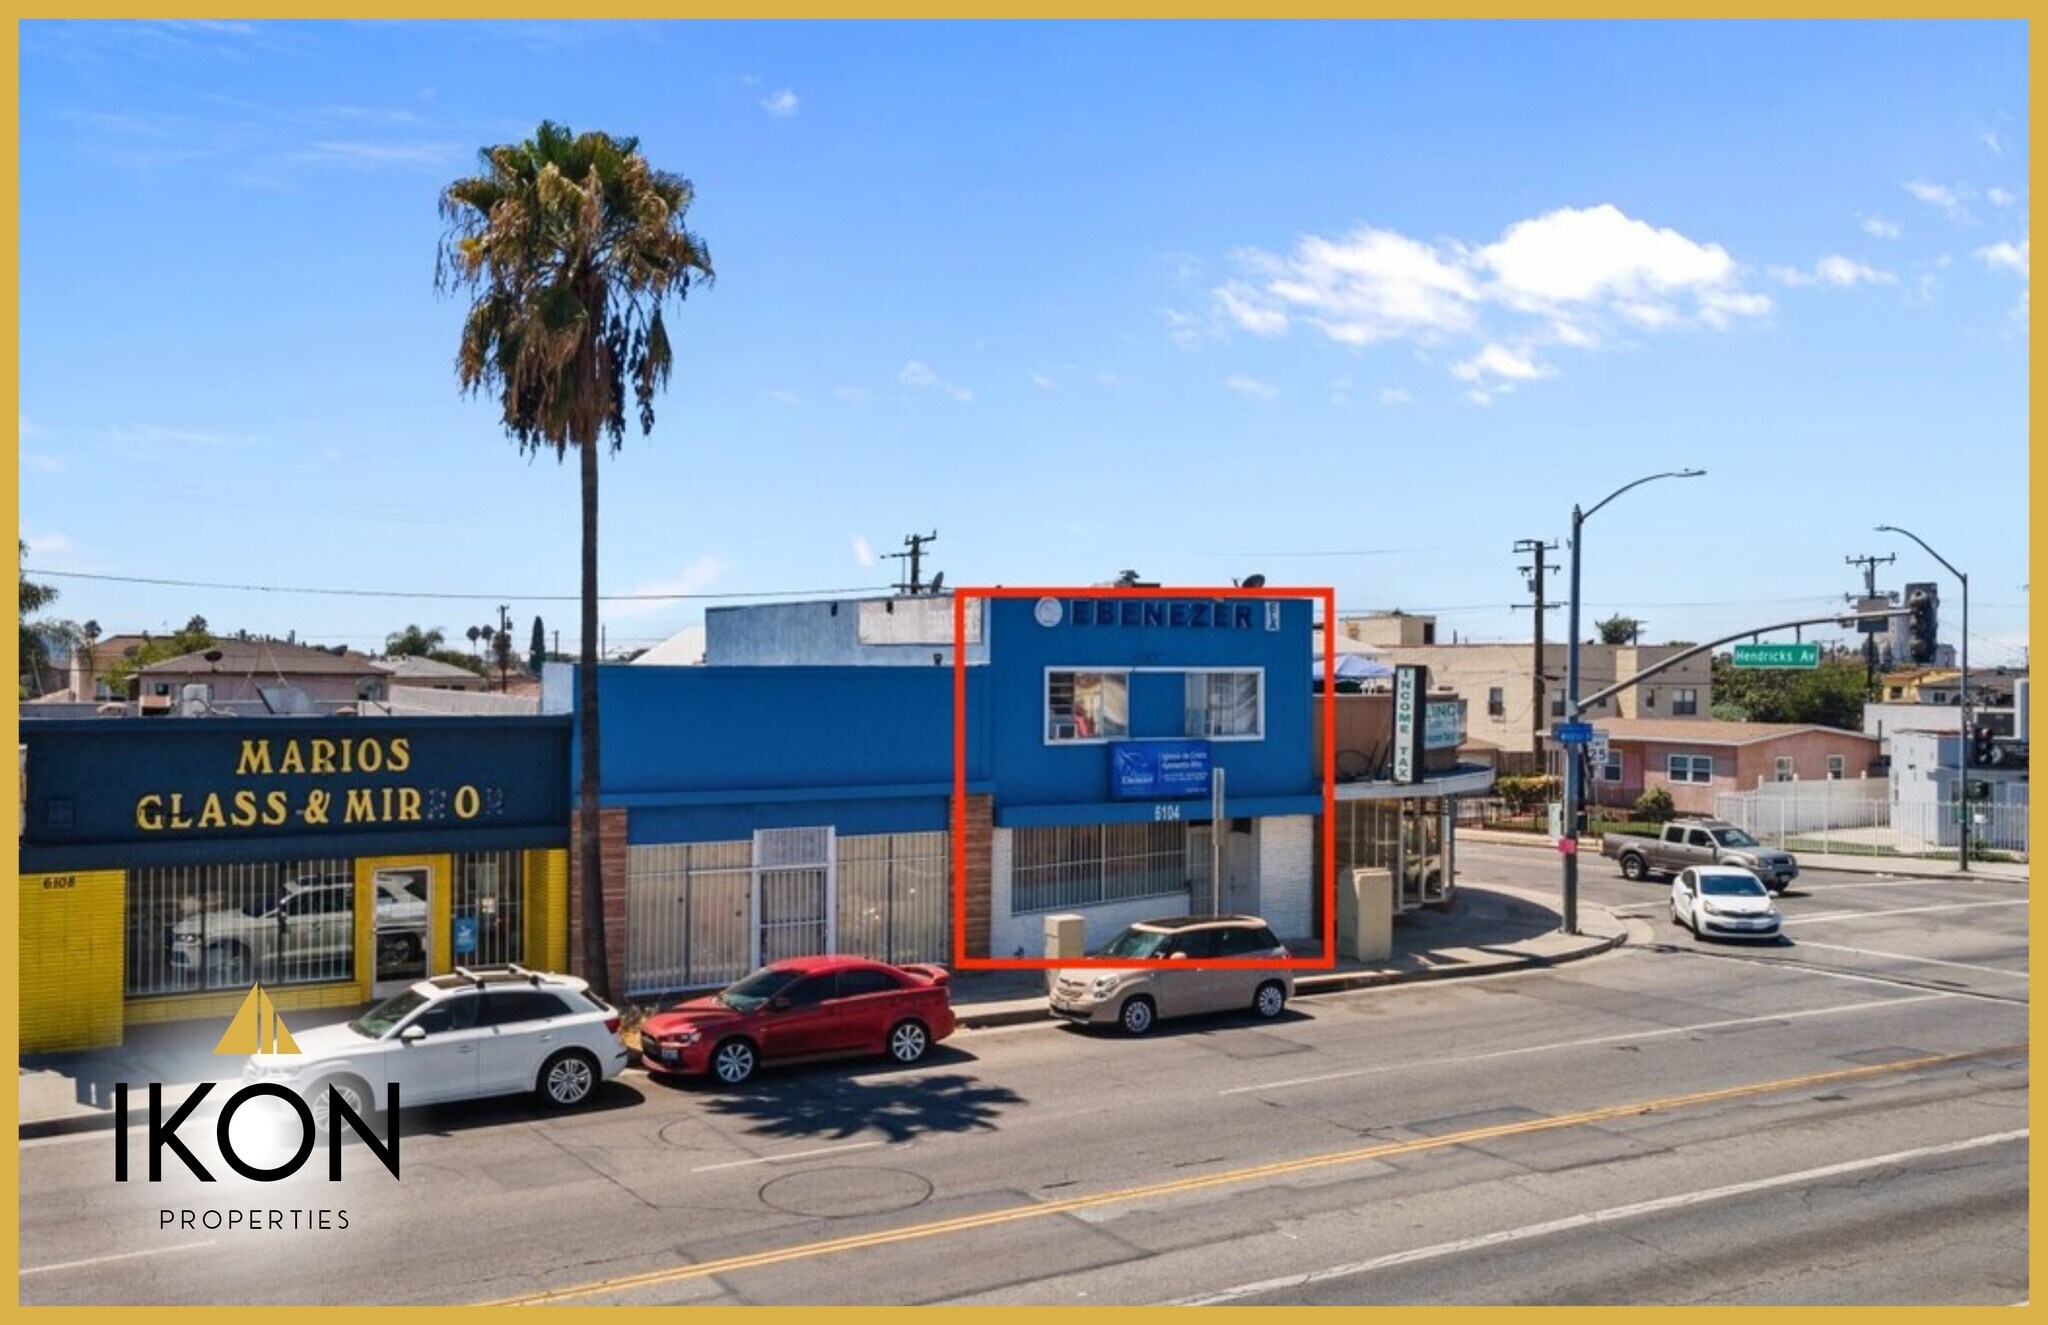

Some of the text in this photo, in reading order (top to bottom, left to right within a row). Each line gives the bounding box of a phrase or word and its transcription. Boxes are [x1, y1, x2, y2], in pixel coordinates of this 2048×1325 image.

[1071, 601, 1252, 628] EBENEZER
[1736, 650, 1815, 662] Hendricks Av
[1398, 669, 1412, 734] INCOME
[236, 739, 410, 774] MARIOS
[1398, 747, 1409, 778] TAX
[136, 791, 288, 830] GLASS
[303, 789, 331, 824] &
[1155, 805, 1180, 821] 6104
[43, 876, 76, 889] 6108
